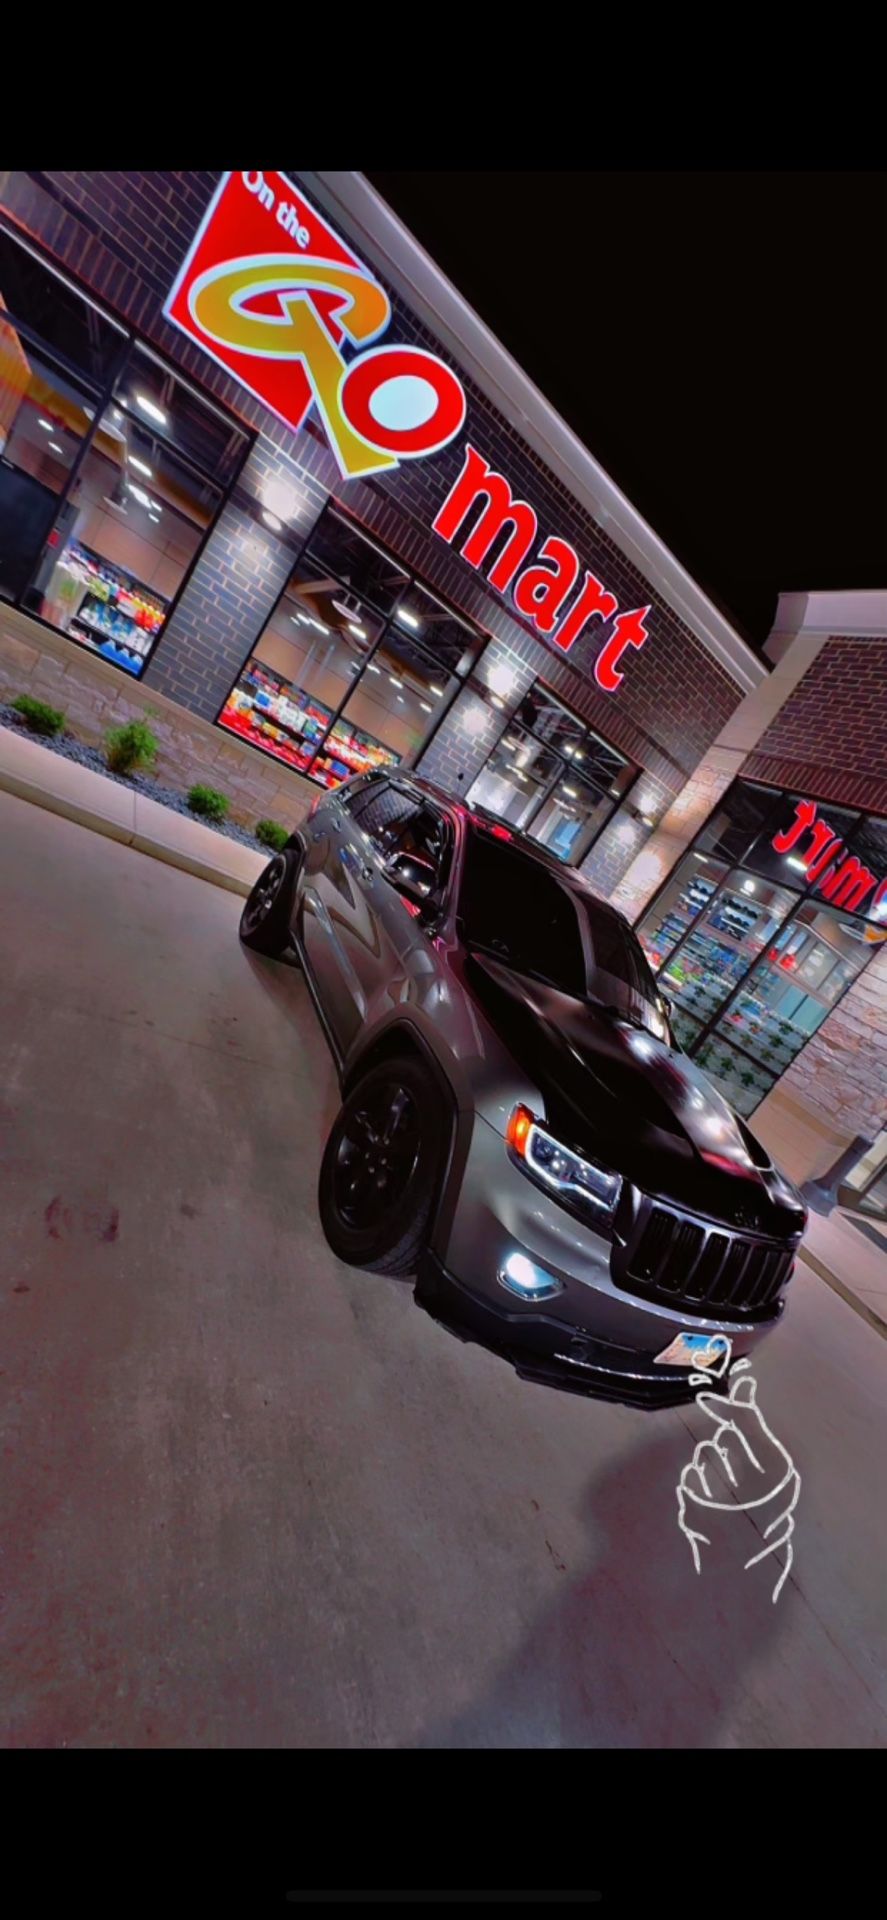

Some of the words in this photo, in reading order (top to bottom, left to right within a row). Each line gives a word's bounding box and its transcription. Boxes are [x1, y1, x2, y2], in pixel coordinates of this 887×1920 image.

[241, 171, 275, 212] On
[276, 202, 310, 249] the
[431, 443, 652, 692] mart
